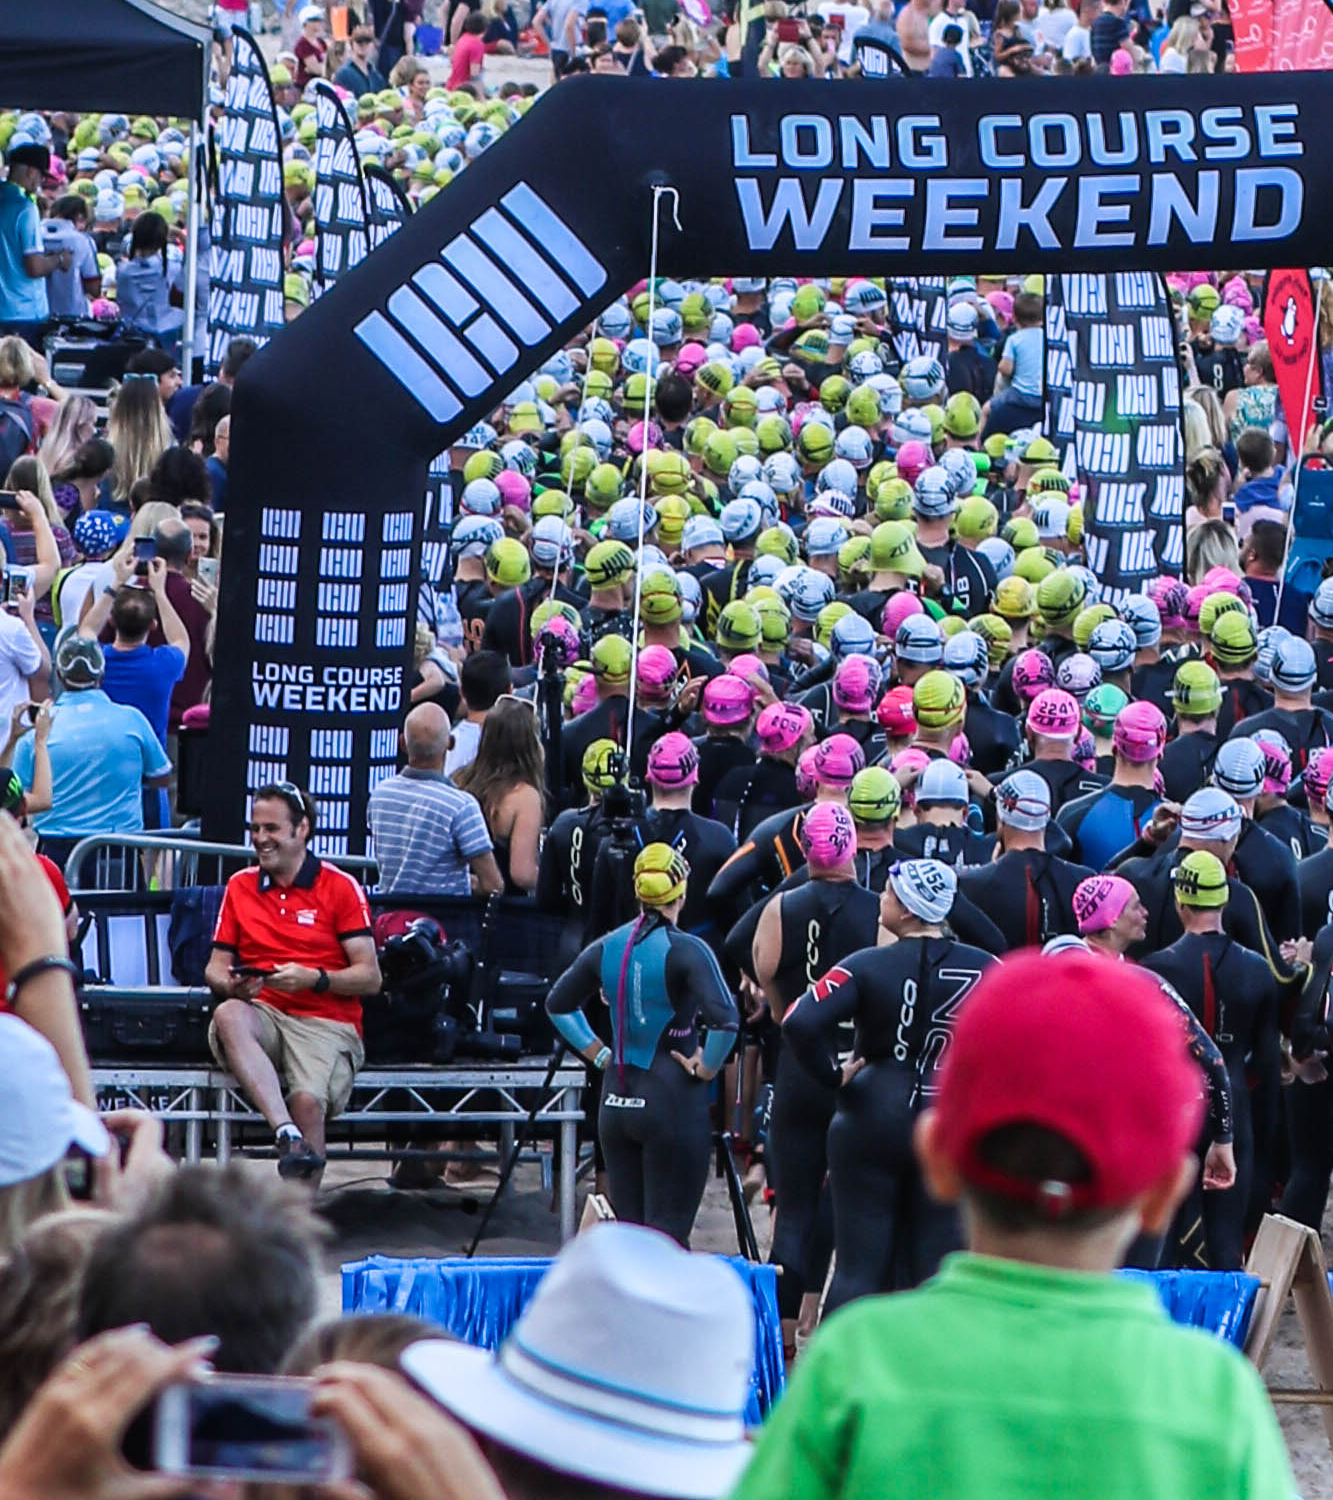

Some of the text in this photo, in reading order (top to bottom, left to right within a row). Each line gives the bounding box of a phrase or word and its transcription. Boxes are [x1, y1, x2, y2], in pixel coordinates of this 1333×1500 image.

[730, 103, 1304, 169] LONG COURSE
[734, 166, 1305, 251] WEEKEND
[252, 661, 403, 686] LONG COURSE
[252, 682, 401, 712] WEEKEND
[1039, 700, 1075, 717] 2241
[569, 826, 584, 906] orca
[919, 861, 947, 895] 1152
[893, 978, 918, 1062] orca
